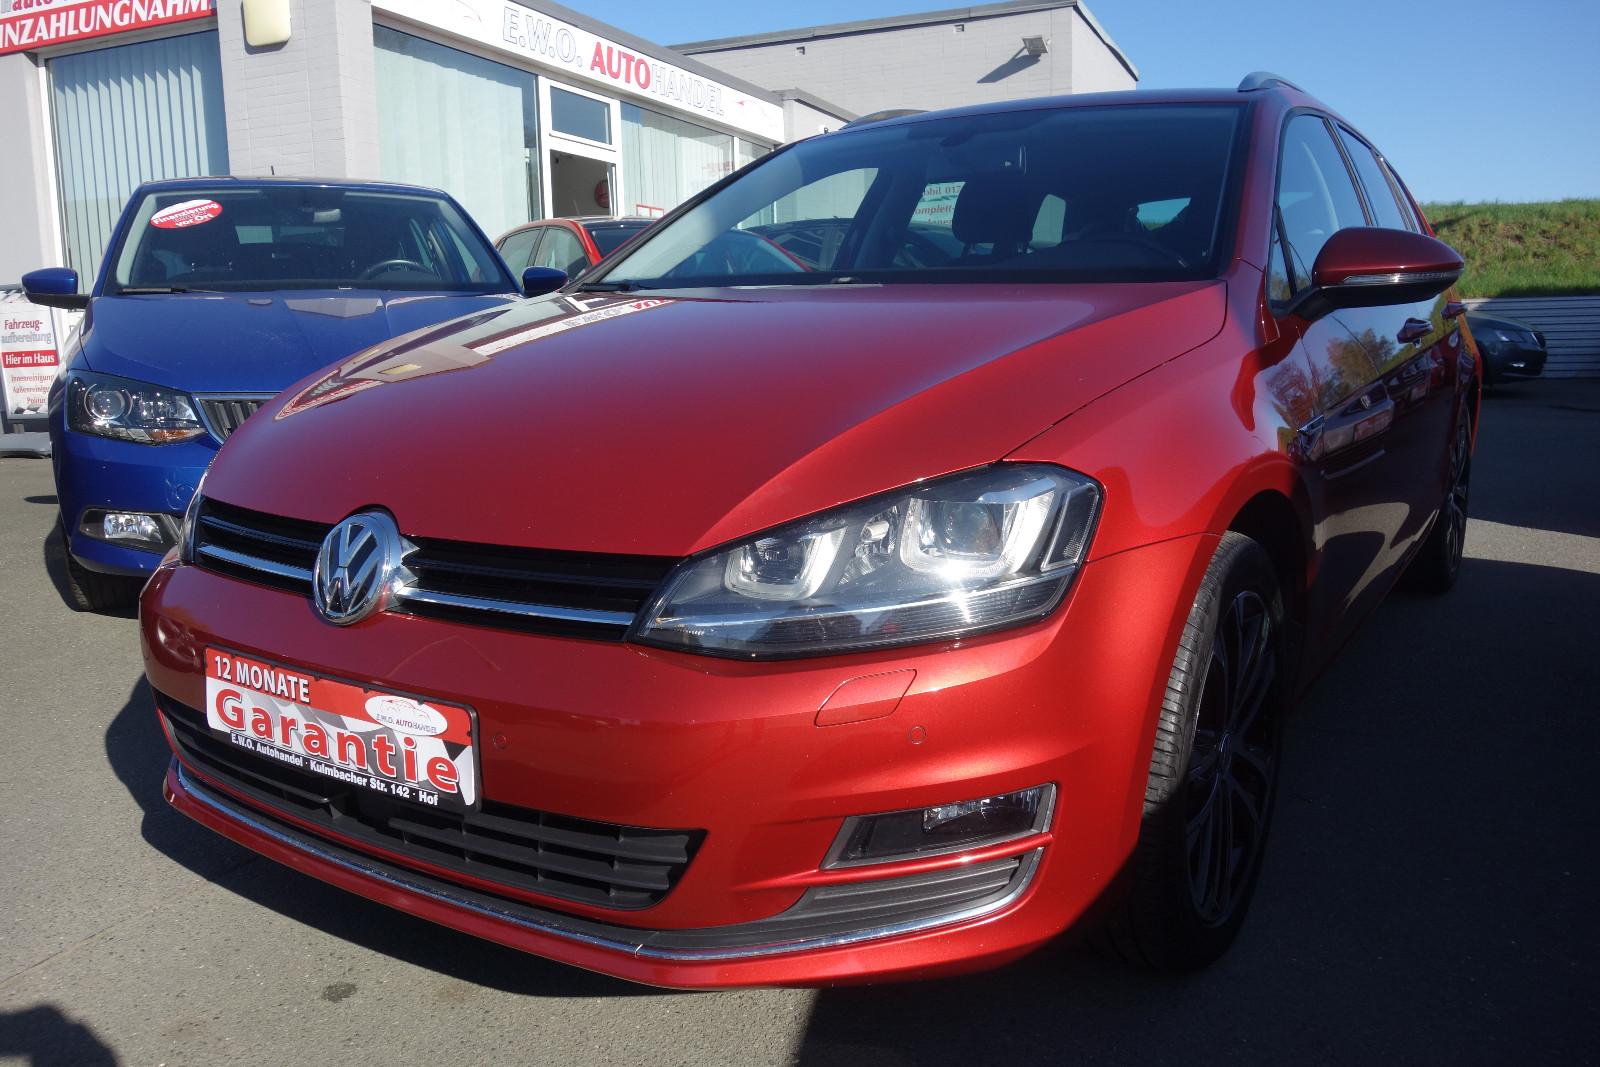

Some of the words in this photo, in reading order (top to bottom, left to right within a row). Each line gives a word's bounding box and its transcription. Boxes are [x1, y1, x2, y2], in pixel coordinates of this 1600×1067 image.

[502, 6, 583, 68] E.W.O.
[590, 41, 724, 117] AUTOHANDEL
[153, 204, 219, 224] Finanzierung
[1, 331, 51, 344] aufbereitung
[4, 319, 43, 331] Fahrzeug-
[5, 354, 21, 365] Hier
[22, 353, 33, 364] im
[33, 352, 55, 363] Haus
[214, 655, 232, 680] 12
[236, 658, 311, 703] MONATE
[215, 687, 460, 794] Garantie
[231, 733, 256, 751] E.W.O.
[256, 742, 304, 768] Autohandel
[310, 760, 368, 787] Kulmbacher
[369, 778, 388, 793] Str.
[390, 784, 410, 799] 142
[418, 790, 439, 806] Hof
